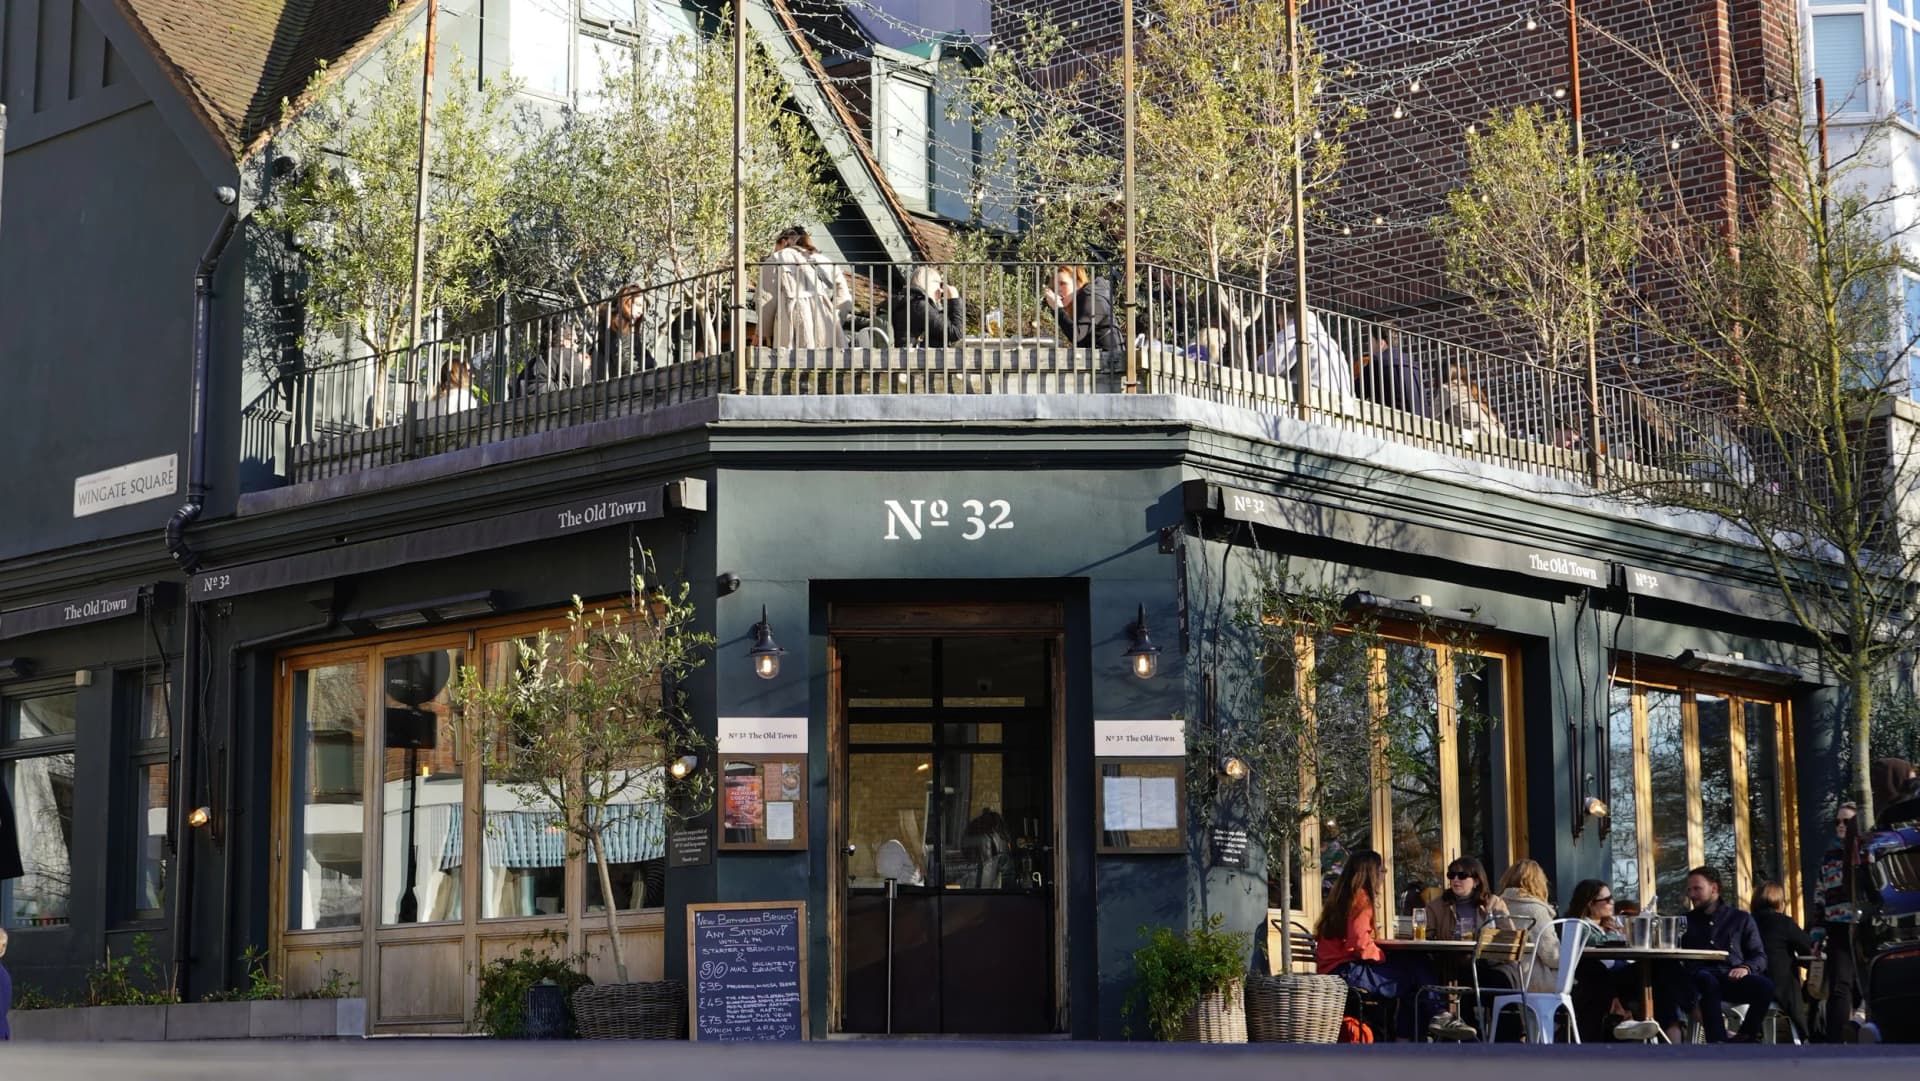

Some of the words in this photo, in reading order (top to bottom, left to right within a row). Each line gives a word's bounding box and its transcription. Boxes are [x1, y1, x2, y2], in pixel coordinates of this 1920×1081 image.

[78, 482, 127, 506] WINGATE
[130, 470, 174, 494] SQUARE
[1253, 498, 1265, 514] 32
[558, 510, 583, 528] The
[584, 502, 607, 523] Old
[609, 500, 647, 518] Town
[961, 499, 1014, 540] 32
[1529, 554, 1549, 572] The
[1550, 558, 1568, 575] Old
[1568, 561, 1597, 580] Town
[219, 575, 230, 589] 32
[1648, 574, 1659, 589] 32
[64, 604, 82, 620] The
[83, 599, 100, 616] Old
[101, 599, 127, 613] Town
[749, 731, 762, 739] The
[763, 731, 776, 739] Old
[1125, 733, 1139, 742] The
[1140, 733, 1153, 742] Old
[705, 930, 725, 939] ANY
[699, 960, 729, 980] 90
[699, 981, 723, 994] £35
[699, 997, 724, 1010] £45
[699, 1015, 722, 1027] £75
